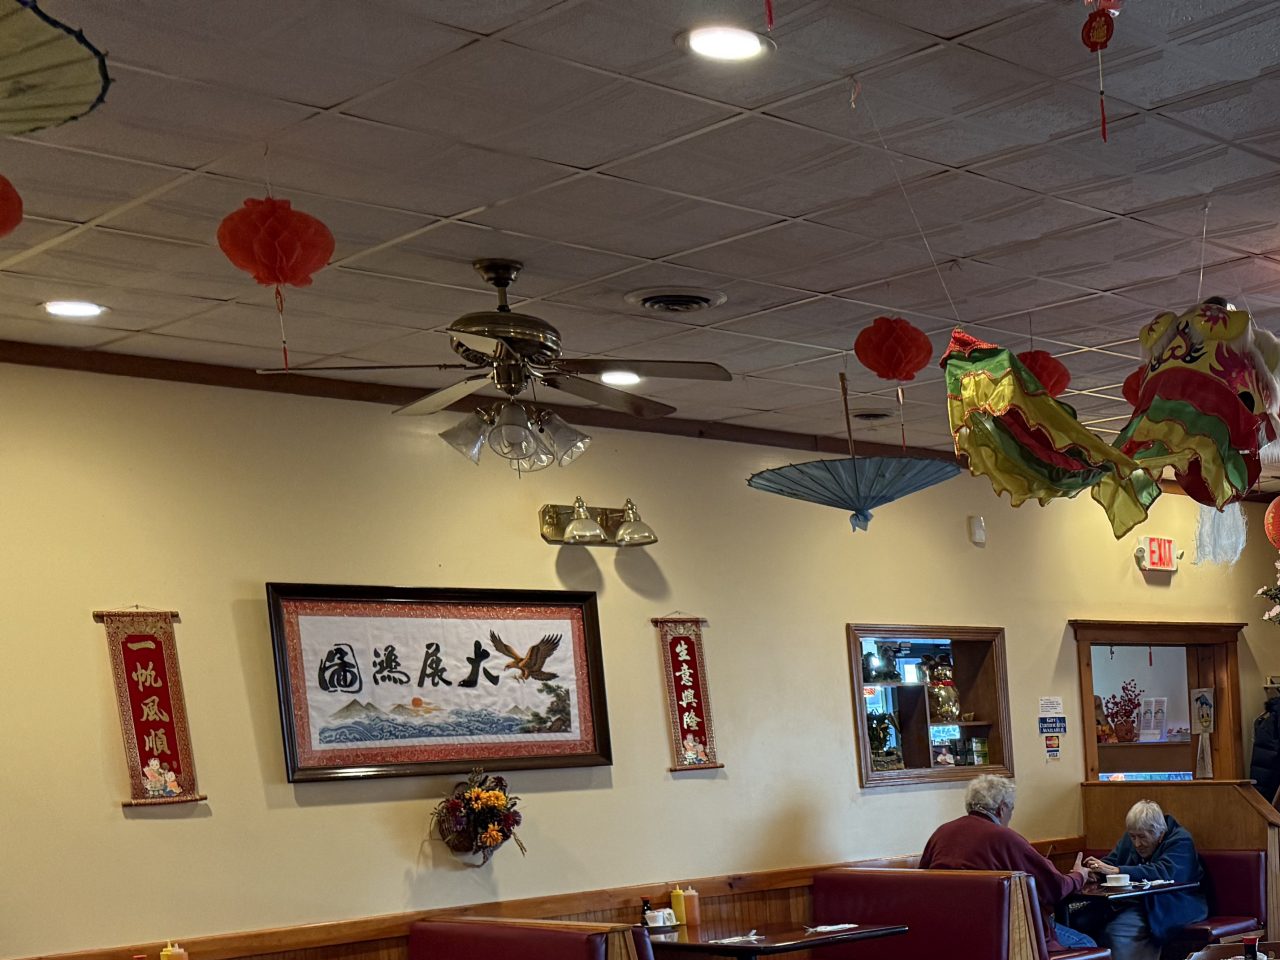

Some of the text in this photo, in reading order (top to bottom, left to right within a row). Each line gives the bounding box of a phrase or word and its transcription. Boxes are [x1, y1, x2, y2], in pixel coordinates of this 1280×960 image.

[1149, 537, 1173, 568] EXIT
[127, 640, 171, 756] 一帆風順
[675, 640, 703, 731] 生意興隆
